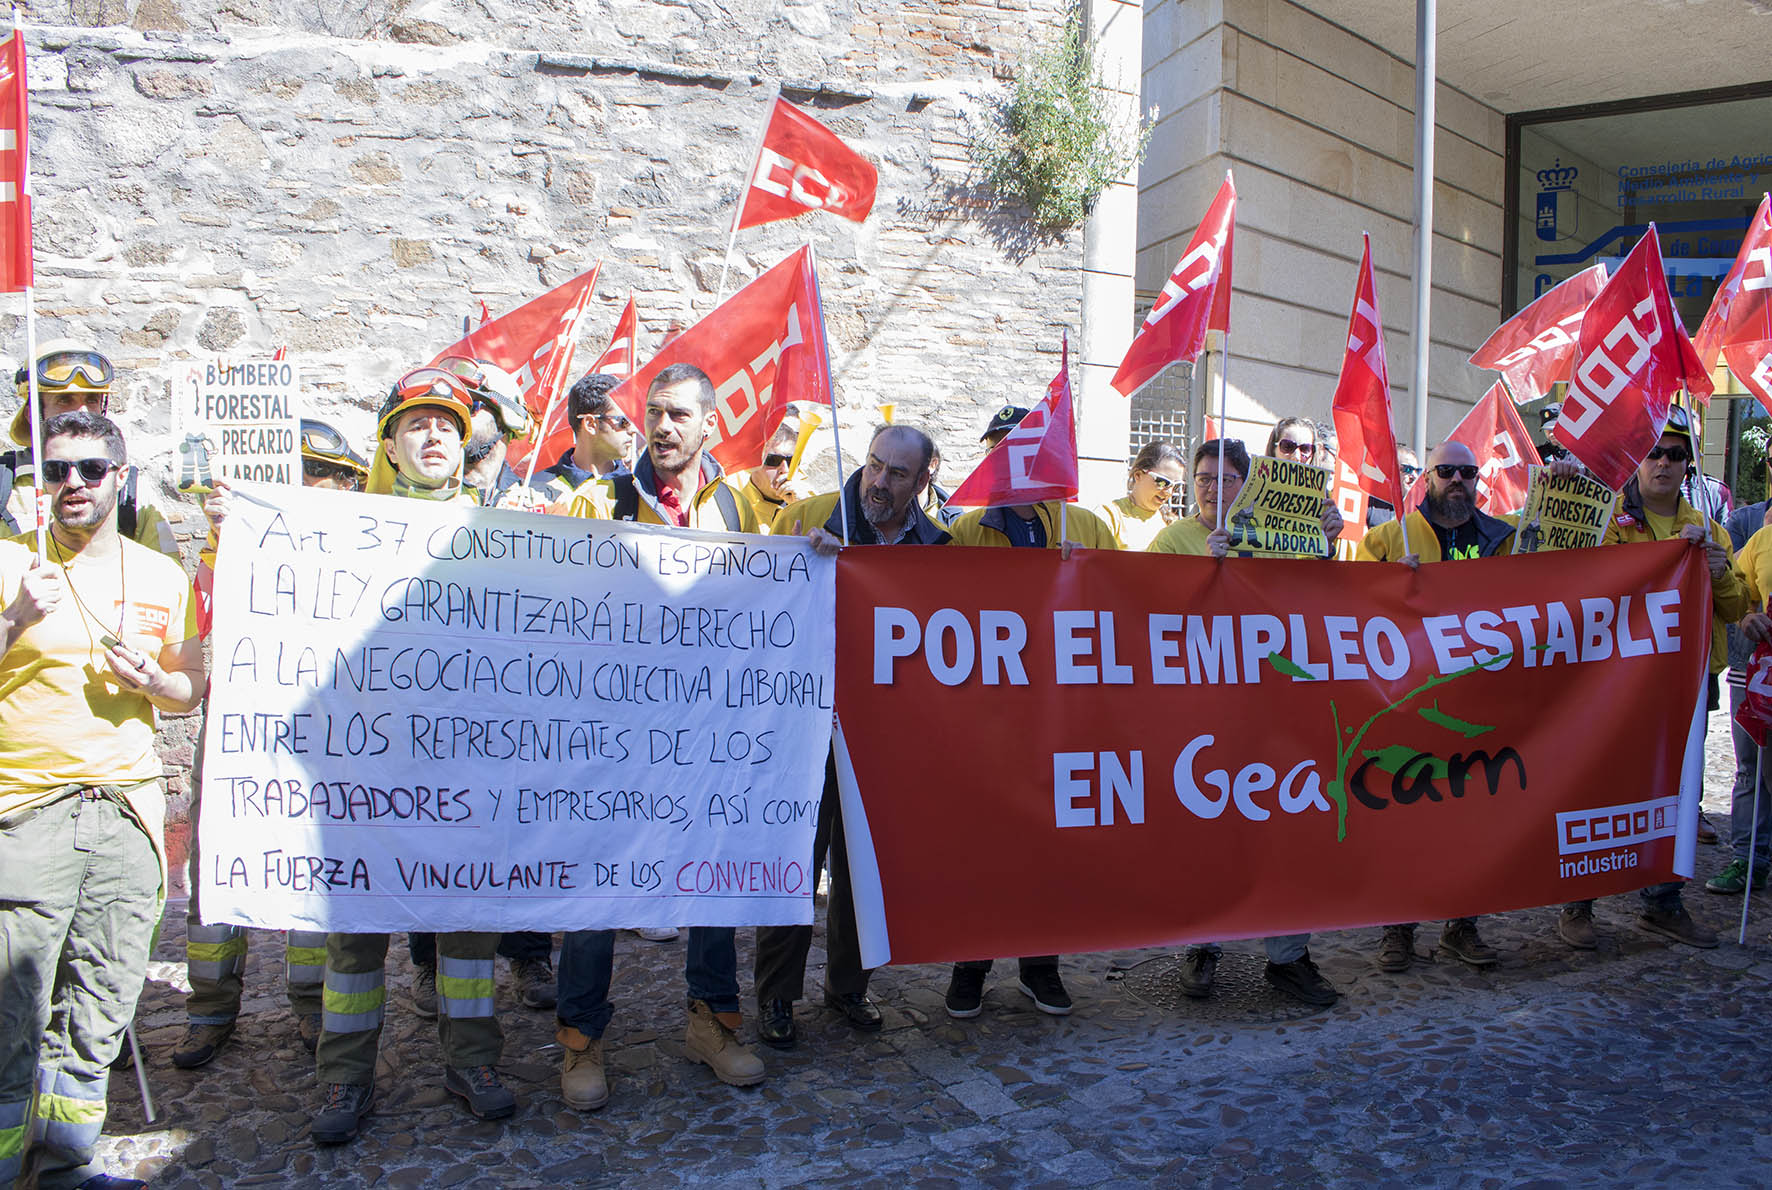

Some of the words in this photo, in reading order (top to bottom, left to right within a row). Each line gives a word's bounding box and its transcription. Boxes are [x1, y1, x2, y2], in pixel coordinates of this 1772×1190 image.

[1706, 156, 1726, 171] de
[1616, 190, 1698, 207] Desarrollo
[1702, 184, 1744, 200] Rural
[1617, 177, 1666, 193] Medio
[1669, 173, 1745, 189] Ambiente
[1749, 172, 1761, 184] y
[1670, 239, 1691, 256] de
[206, 363, 292, 386] BOMBERO
[205, 394, 293, 420] FORESTAL
[222, 429, 293, 455] PRECARIO
[1271, 460, 1325, 491] BOMBERO
[1550, 474, 1611, 504] BOMBERO
[1260, 489, 1323, 519] FORESTAL
[1545, 496, 1604, 528] FORESTAL
[259, 513, 332, 554] Art.
[357, 516, 409, 555] 37
[658, 541, 810, 583] ESPAÑOLA
[1264, 530, 1324, 553] LABORAL
[1547, 526, 1597, 549] PRECARIO
[250, 562, 297, 617] LA
[312, 566, 372, 620] LEY
[623, 602, 651, 645] EL
[660, 605, 796, 650] DERECHO
[873, 606, 1030, 686] POR
[1053, 610, 1134, 685] EL
[1148, 612, 1411, 685] EMPLEO
[1422, 589, 1681, 675] ESTABLE
[229, 636, 257, 683] A
[276, 641, 319, 688] LA
[593, 663, 712, 705] COLECTIVA
[726, 665, 831, 710] LABORAL
[221, 713, 312, 755] ENTRE
[325, 711, 392, 757] LOS
[406, 714, 633, 764] REPRESENTATES
[649, 728, 694, 766] DE
[709, 730, 775, 766] LOS
[214, 776, 472, 822] TRABAJADORES
[488, 788, 502, 822] Y
[517, 788, 695, 832] EMPRESARIOS,
[708, 786, 752, 828] ASÍ
[1053, 749, 1145, 828] EN
[1565, 809, 1649, 845] CCOO
[215, 854, 249, 888] LA
[263, 849, 371, 891] FUERZA
[395, 856, 580, 892] VINCULANTE
[593, 862, 619, 889] DE
[631, 860, 665, 891] LOS
[1559, 848, 1639, 879] industria
